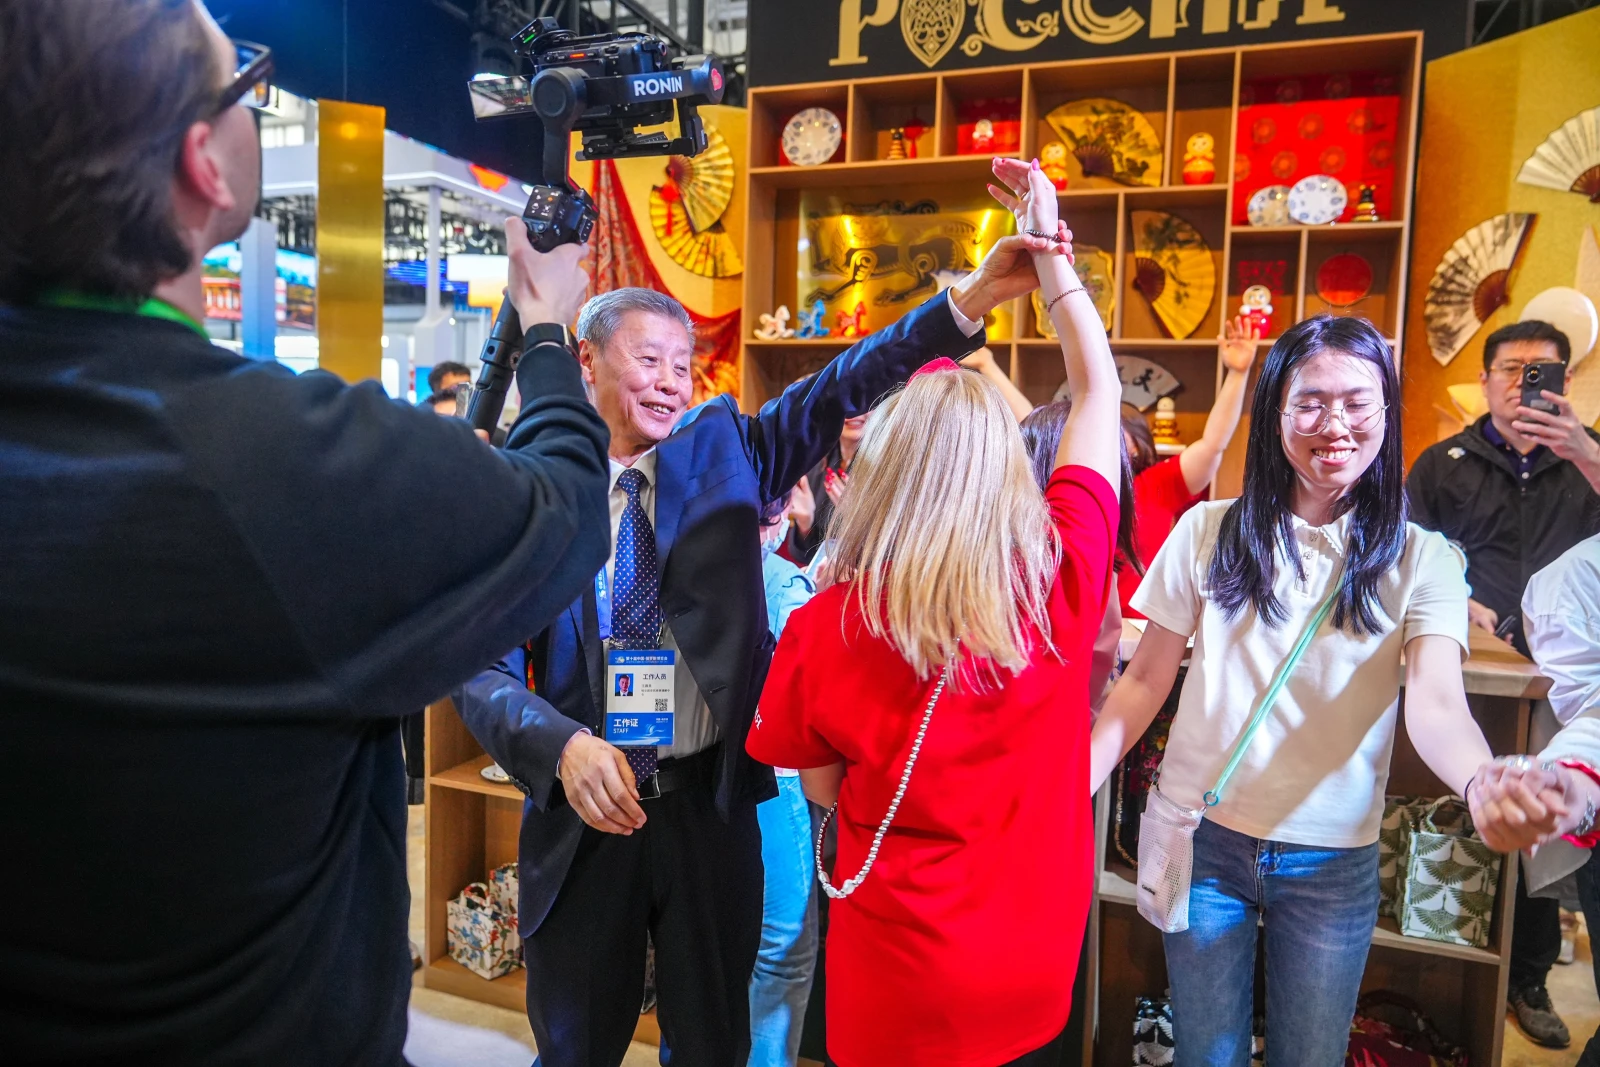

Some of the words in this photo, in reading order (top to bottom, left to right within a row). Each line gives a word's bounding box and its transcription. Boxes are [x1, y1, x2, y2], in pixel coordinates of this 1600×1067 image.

[633, 76, 683, 97] RONIN
[613, 718, 639, 727] 工作证
